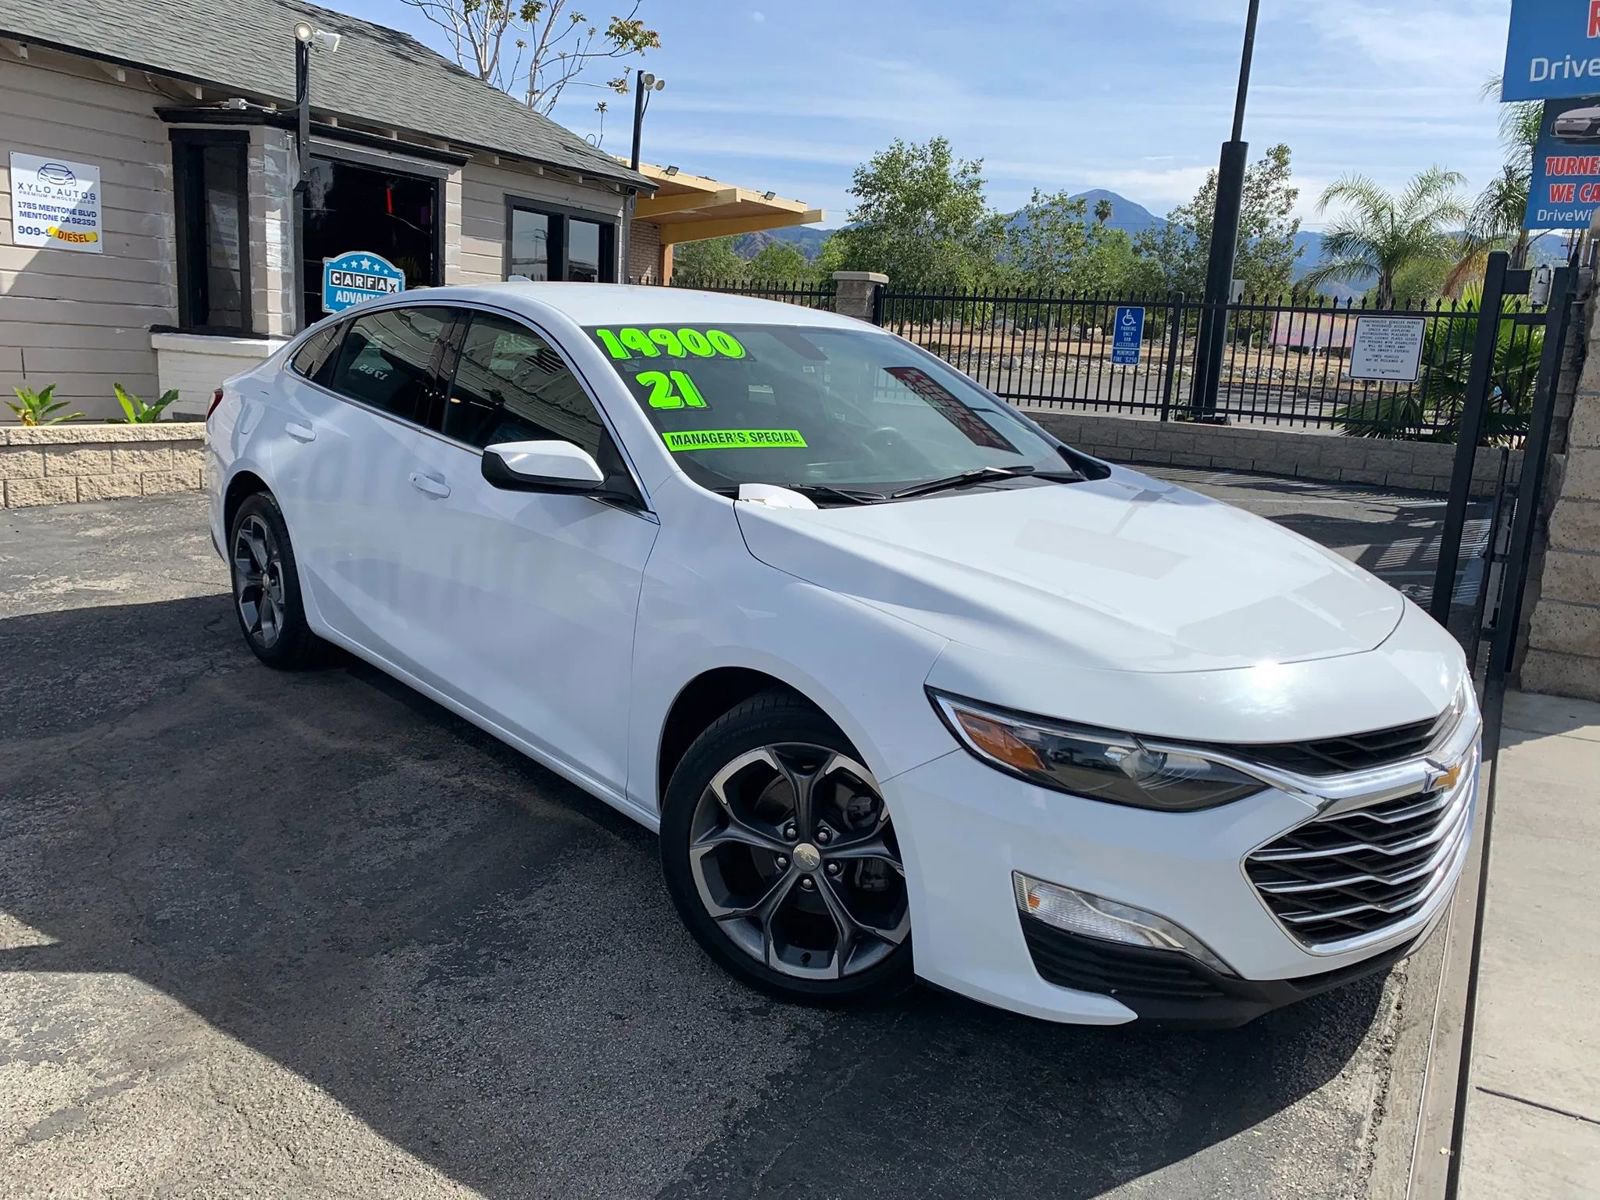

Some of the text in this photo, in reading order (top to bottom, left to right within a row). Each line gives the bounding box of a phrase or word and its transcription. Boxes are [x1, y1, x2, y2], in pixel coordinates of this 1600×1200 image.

[18, 182, 96, 200] XYLO AUTOS
[1549, 183, 1576, 203] WE
[19, 210, 58, 221] MENTONE
[38, 204, 77, 215] MENTONE
[78, 210, 96, 218] BLVD
[1536, 208, 1592, 222] DriveWi
[58, 230, 90, 242] DIESEL
[331, 272, 396, 294] CARFAX
[596, 327, 747, 359] 14900
[635, 370, 709, 409] 21
[670, 431, 799, 447] MANAGER'S SPECIAL
